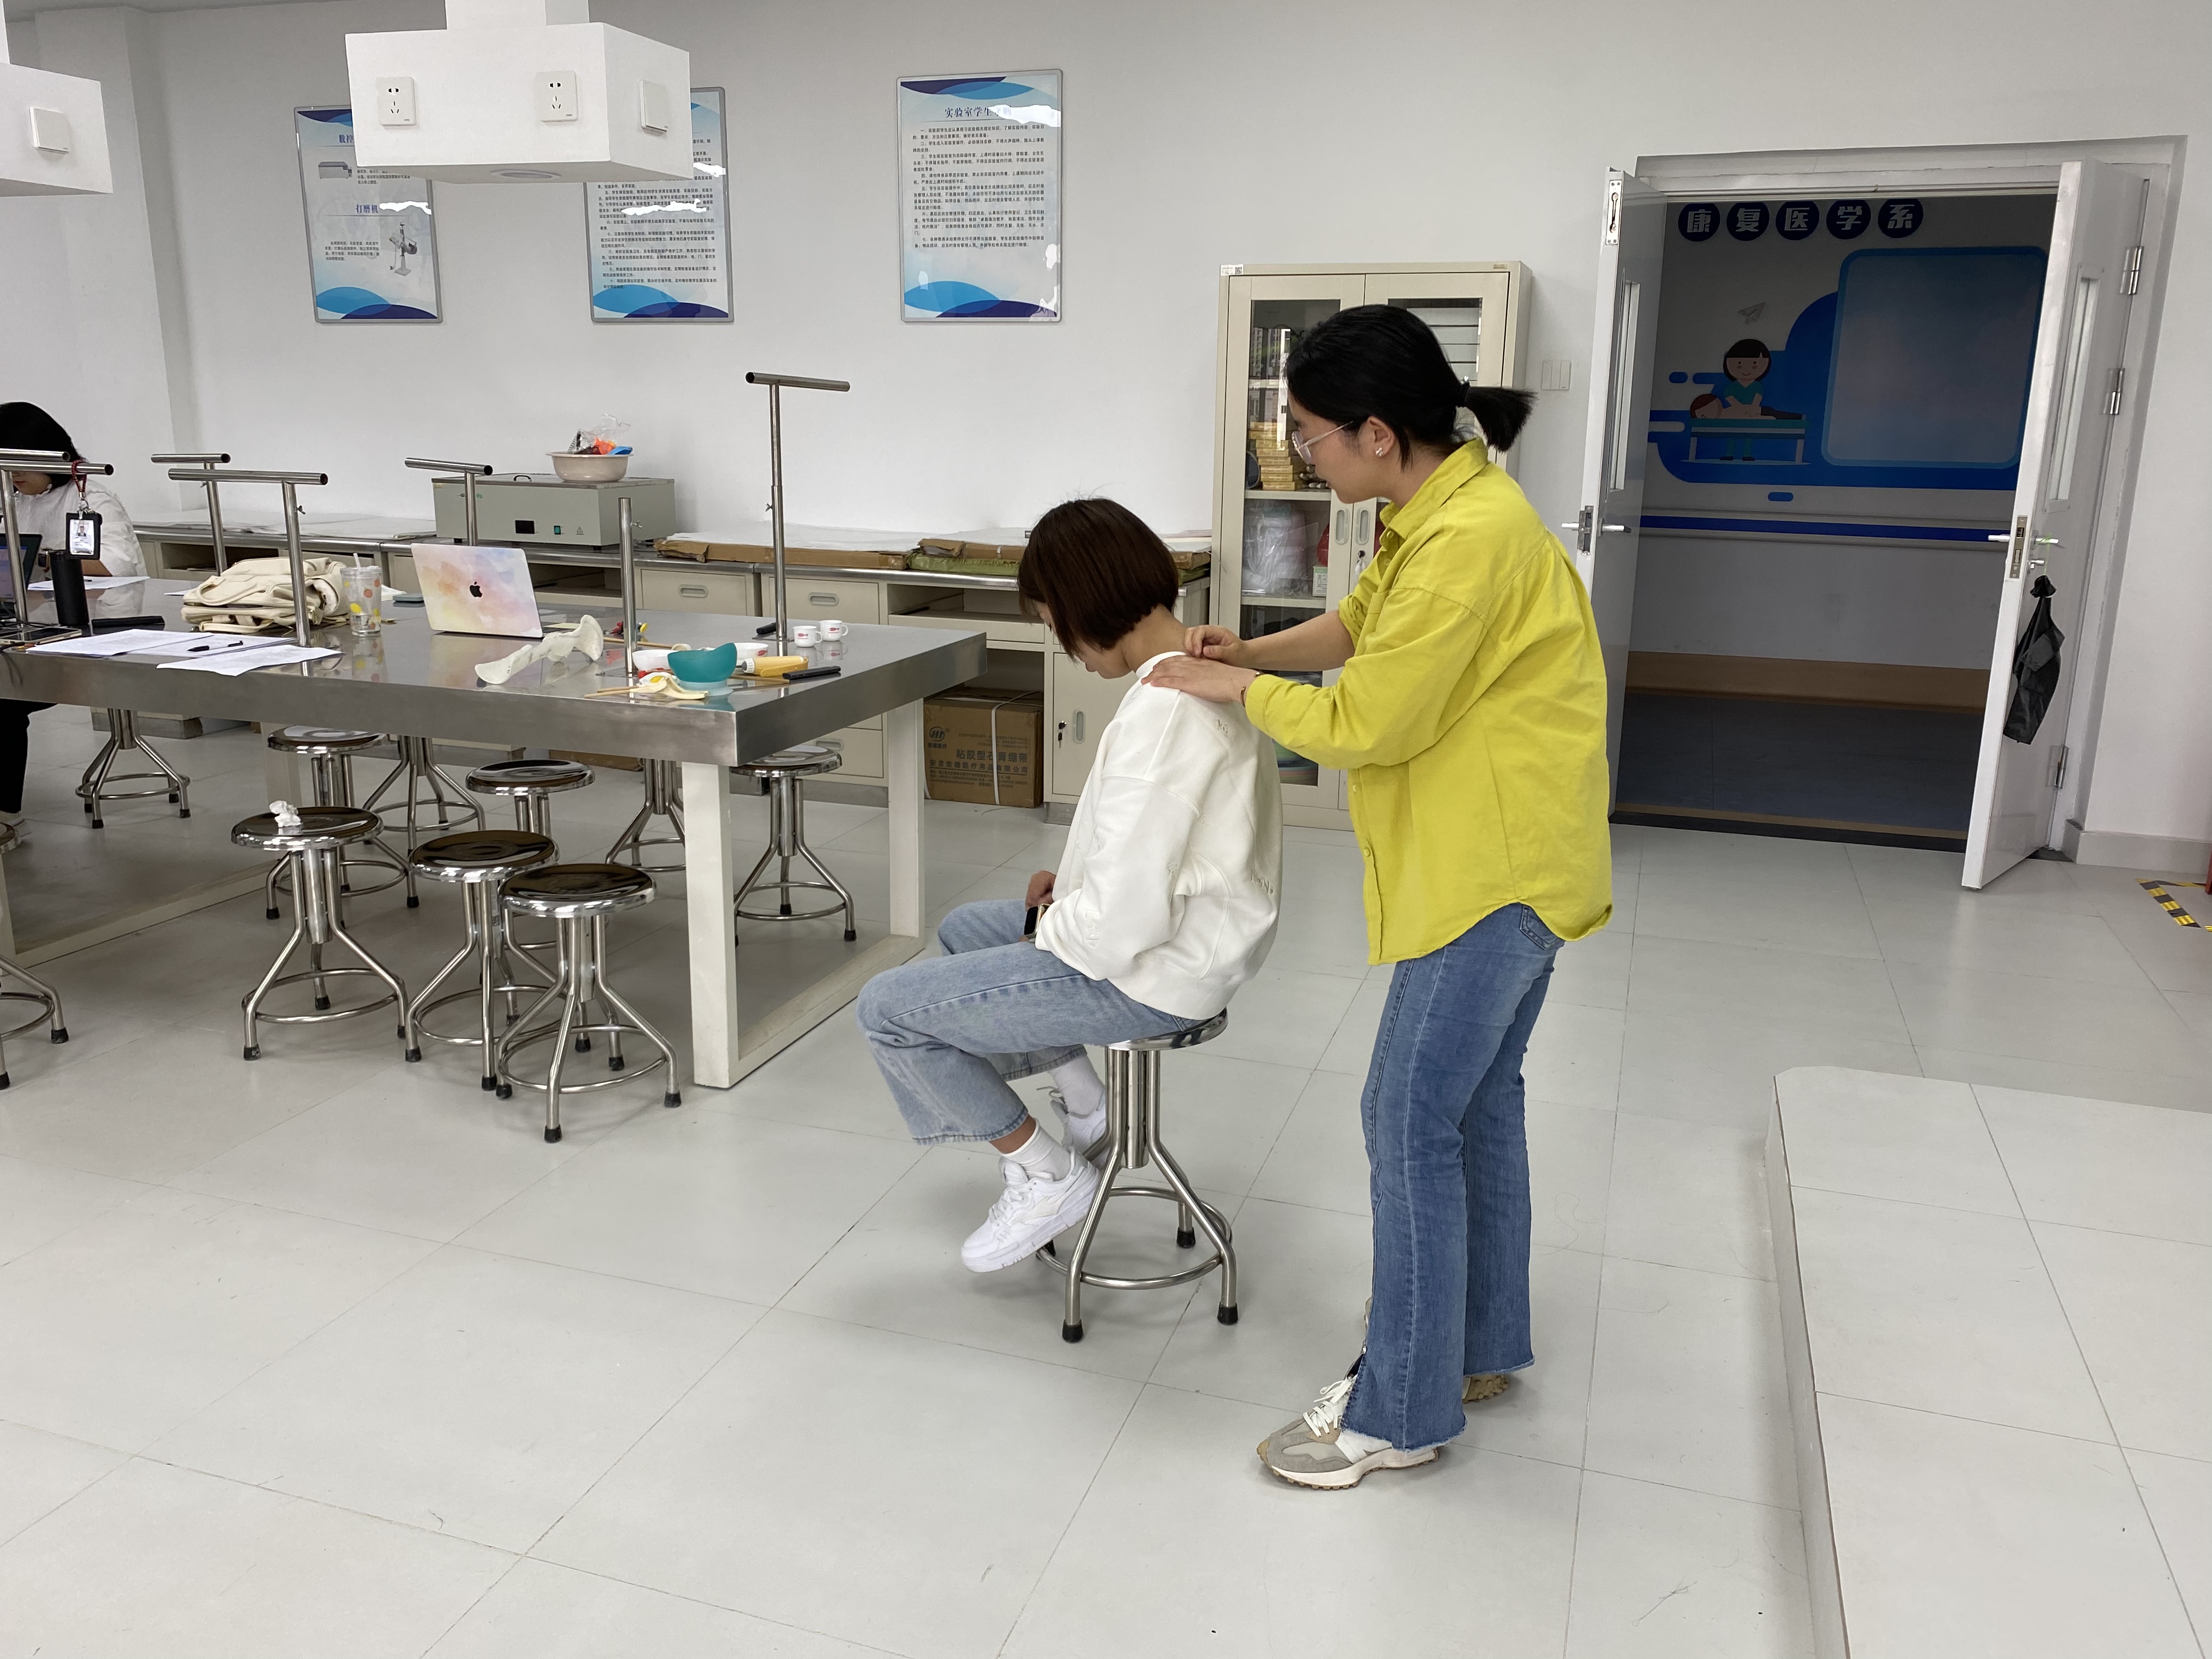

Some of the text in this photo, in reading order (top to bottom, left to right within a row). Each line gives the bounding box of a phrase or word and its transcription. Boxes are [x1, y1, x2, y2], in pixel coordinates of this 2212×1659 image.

[356, 204, 379, 213] 打磨机
[1686, 203, 1914, 234] 康复医学系
